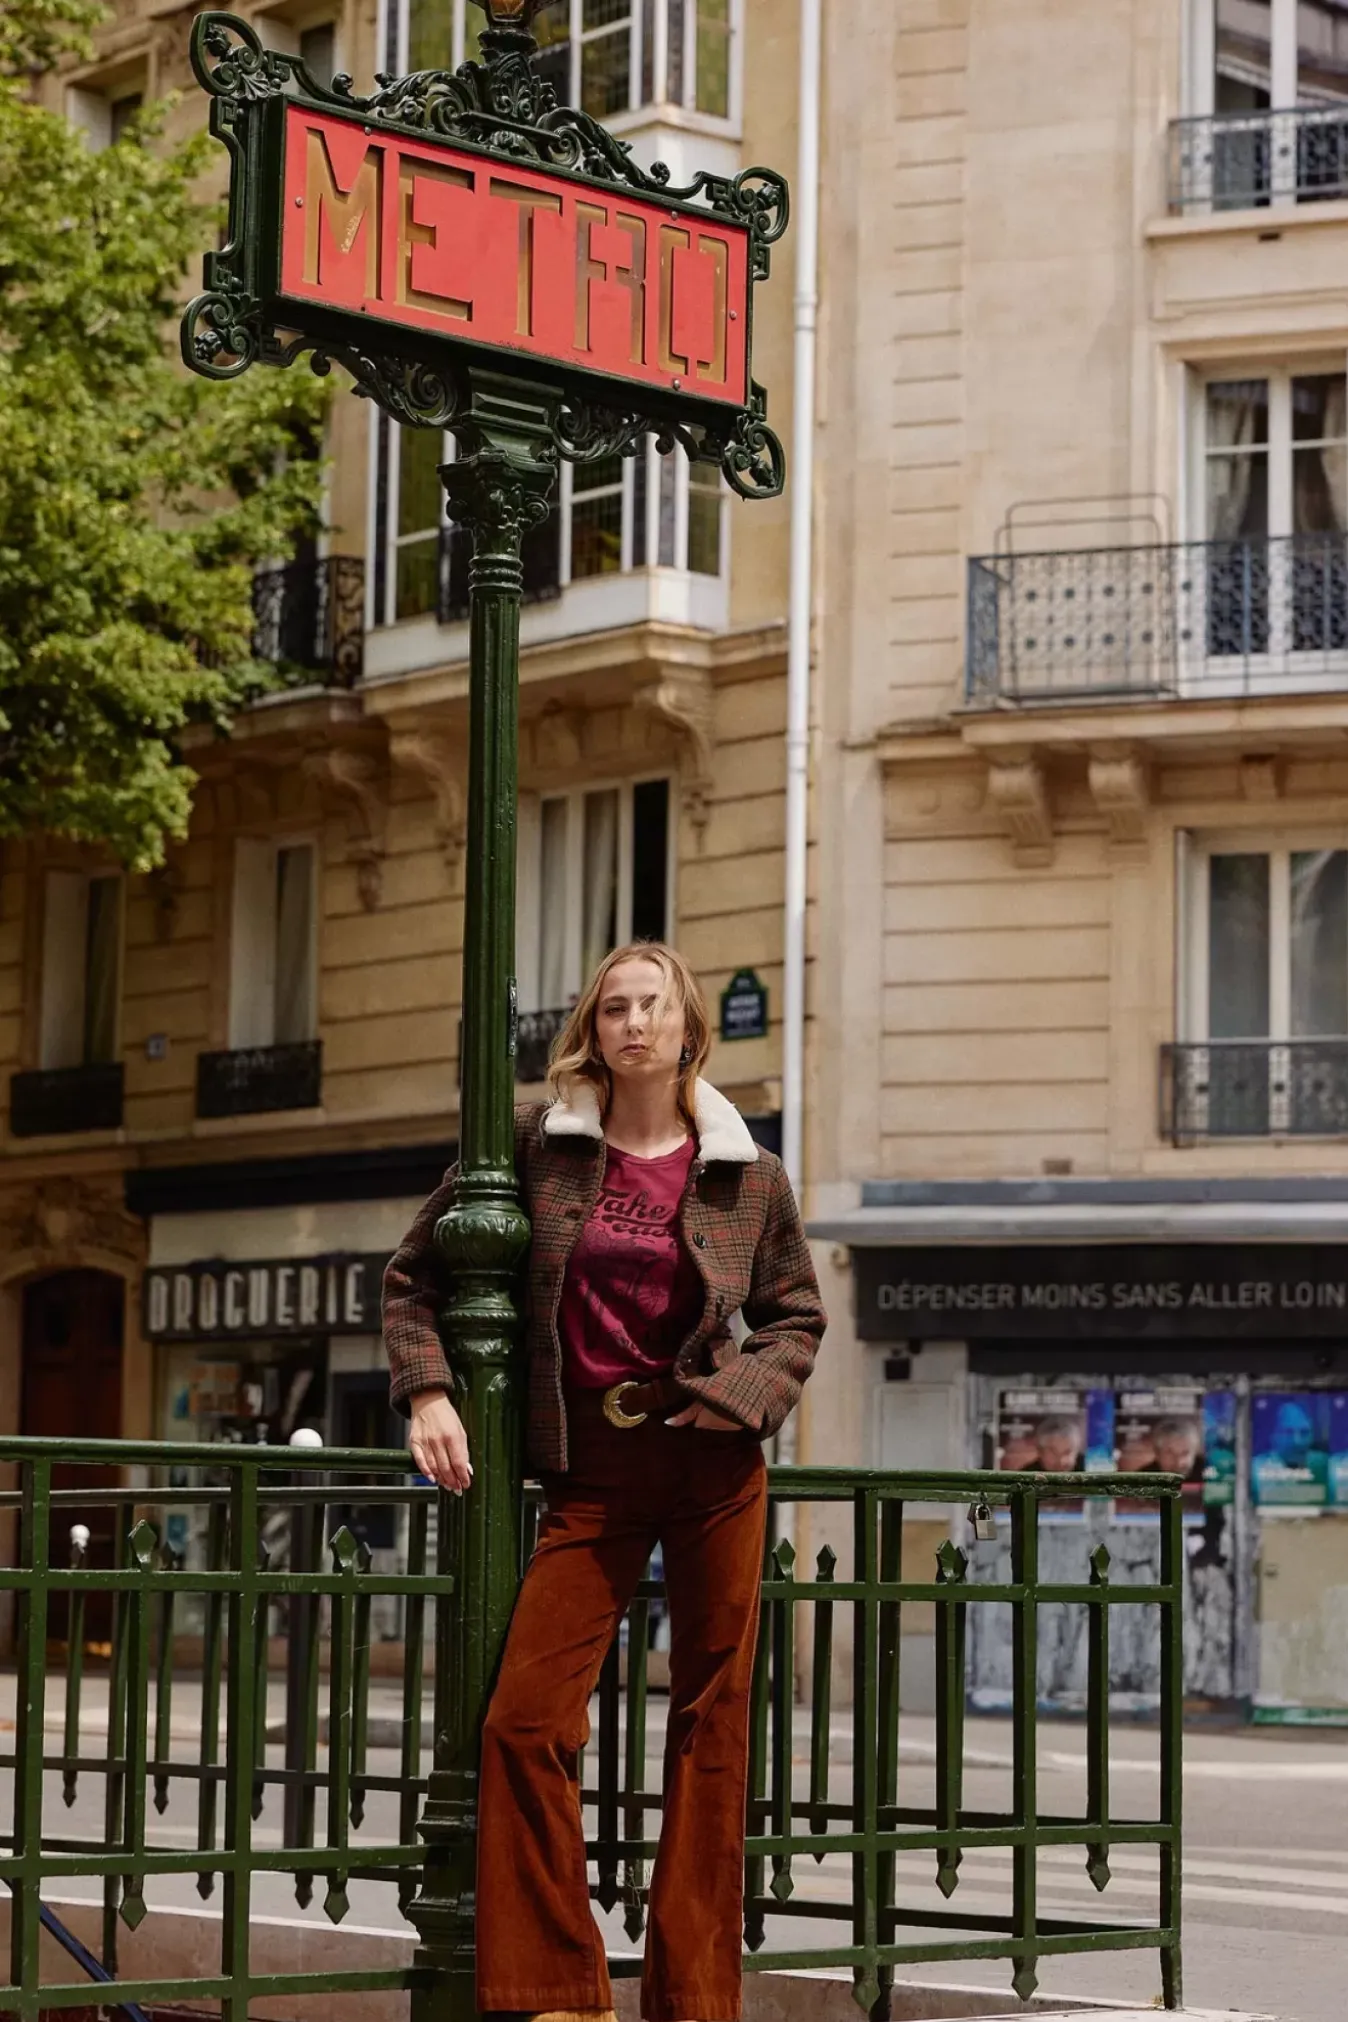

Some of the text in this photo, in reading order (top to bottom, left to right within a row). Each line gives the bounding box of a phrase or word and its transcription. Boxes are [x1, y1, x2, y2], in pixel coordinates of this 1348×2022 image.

[302, 126, 728, 383] METRO
[148, 1262, 365, 1333] DROGUERIE
[877, 1278, 1347, 1310] DÉPENSER MOINS SANS ALLER LOIN
